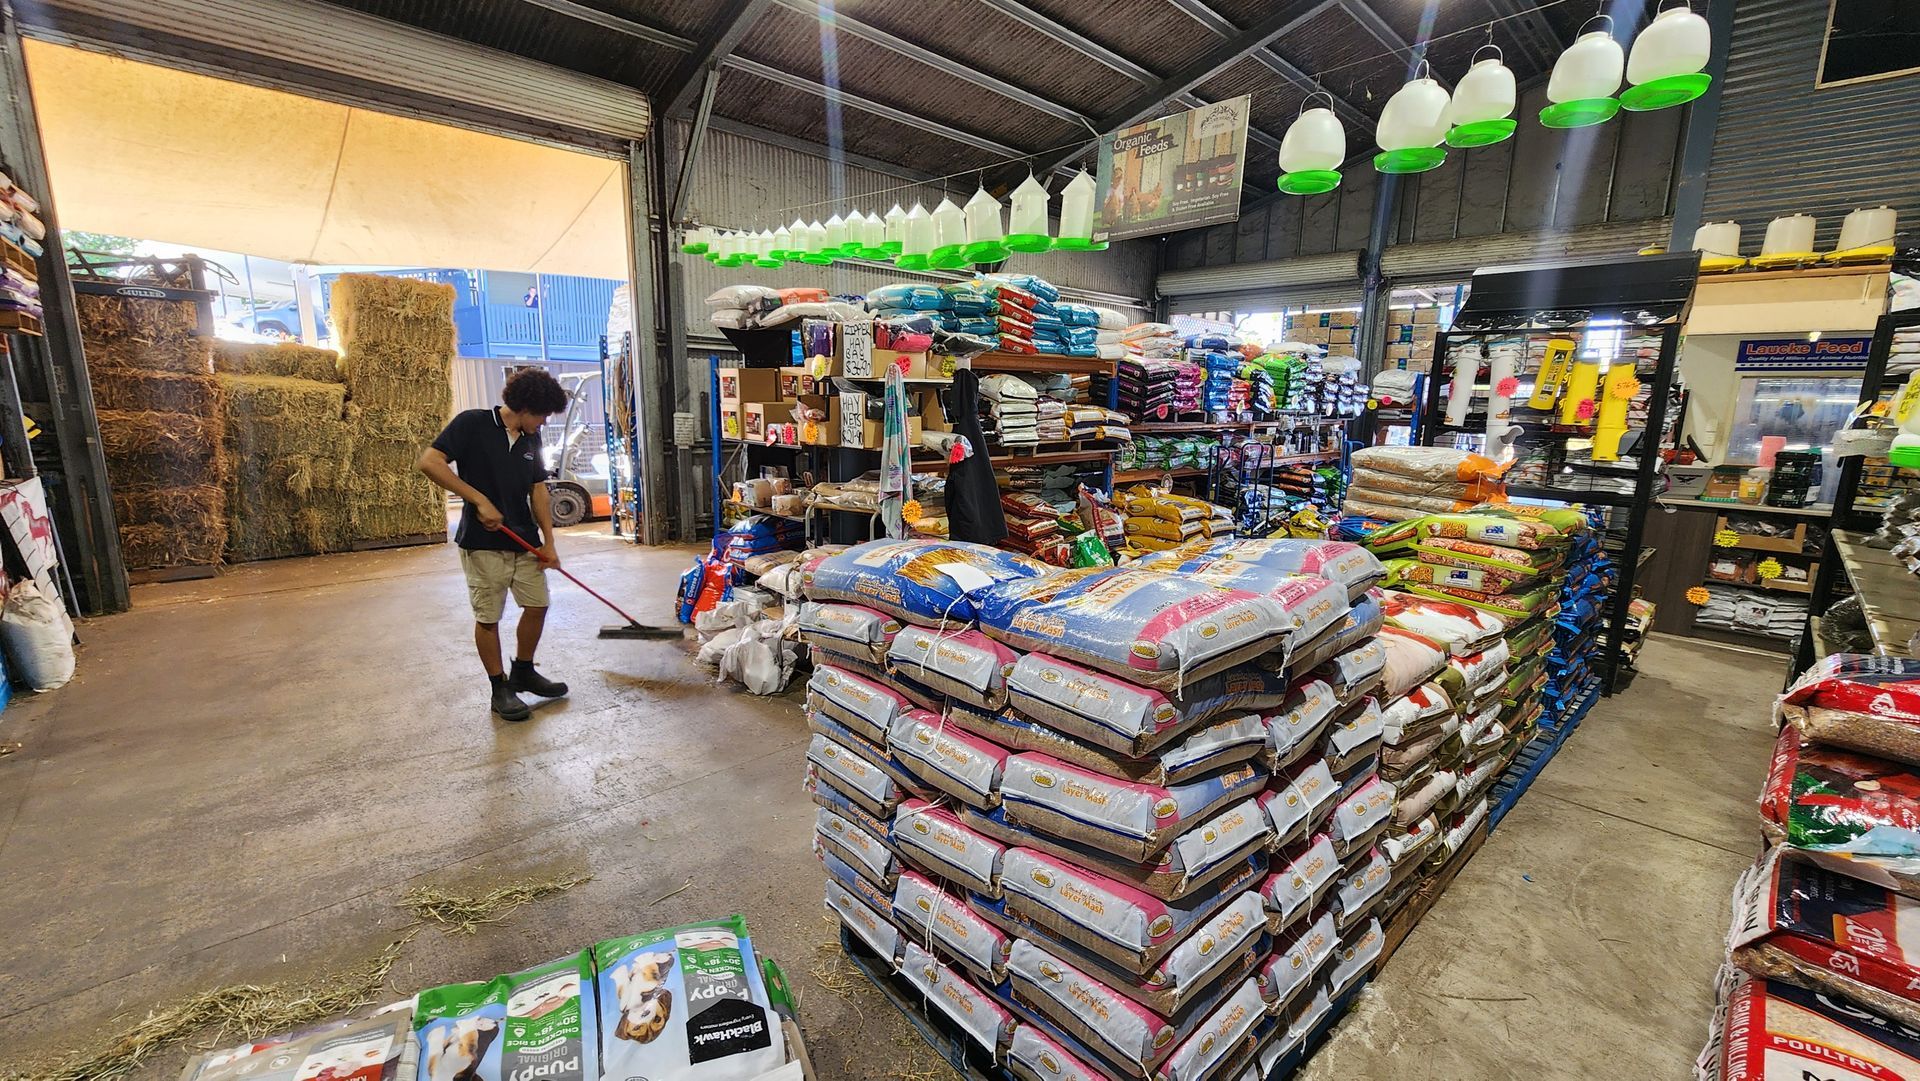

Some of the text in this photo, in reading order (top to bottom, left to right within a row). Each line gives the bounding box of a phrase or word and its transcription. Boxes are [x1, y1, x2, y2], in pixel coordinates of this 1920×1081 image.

[1113, 132, 1152, 151] Organic
[1139, 139, 1169, 156] Feeds
[844, 323, 871, 336] ZIPPER
[850, 338, 865, 349] HAY
[1746, 341, 1864, 356] Laucke Feed
[842, 394, 860, 409] HAY
[842, 413, 862, 427] NETS
[686, 574, 699, 598] Coarse
[856, 582, 900, 603] Layer Mash
[1096, 578, 1138, 604] Layer
[1012, 616, 1065, 638] Layer Mash
[1223, 613, 1258, 630] Layer Mash
[1062, 785, 1084, 800] Layer
[1084, 791, 1108, 805] Mash
[1065, 883, 1087, 898] Country
[1059, 886, 1105, 916] Layer Mash
[1068, 984, 1110, 1021] Layer Mash
[1729, 999, 1752, 1031] GRAIN
[534, 1014, 578, 1038] 30% 18%
[694, 1020, 763, 1045] BlackHawk
[1729, 1027, 1750, 1041] &
[539, 1027, 579, 1046] CHICKEN
[518, 1045, 568, 1065] ORIGINAL
[1727, 1036, 1749, 1081] MILLING
[1773, 1036, 1883, 1074] POULTRY
